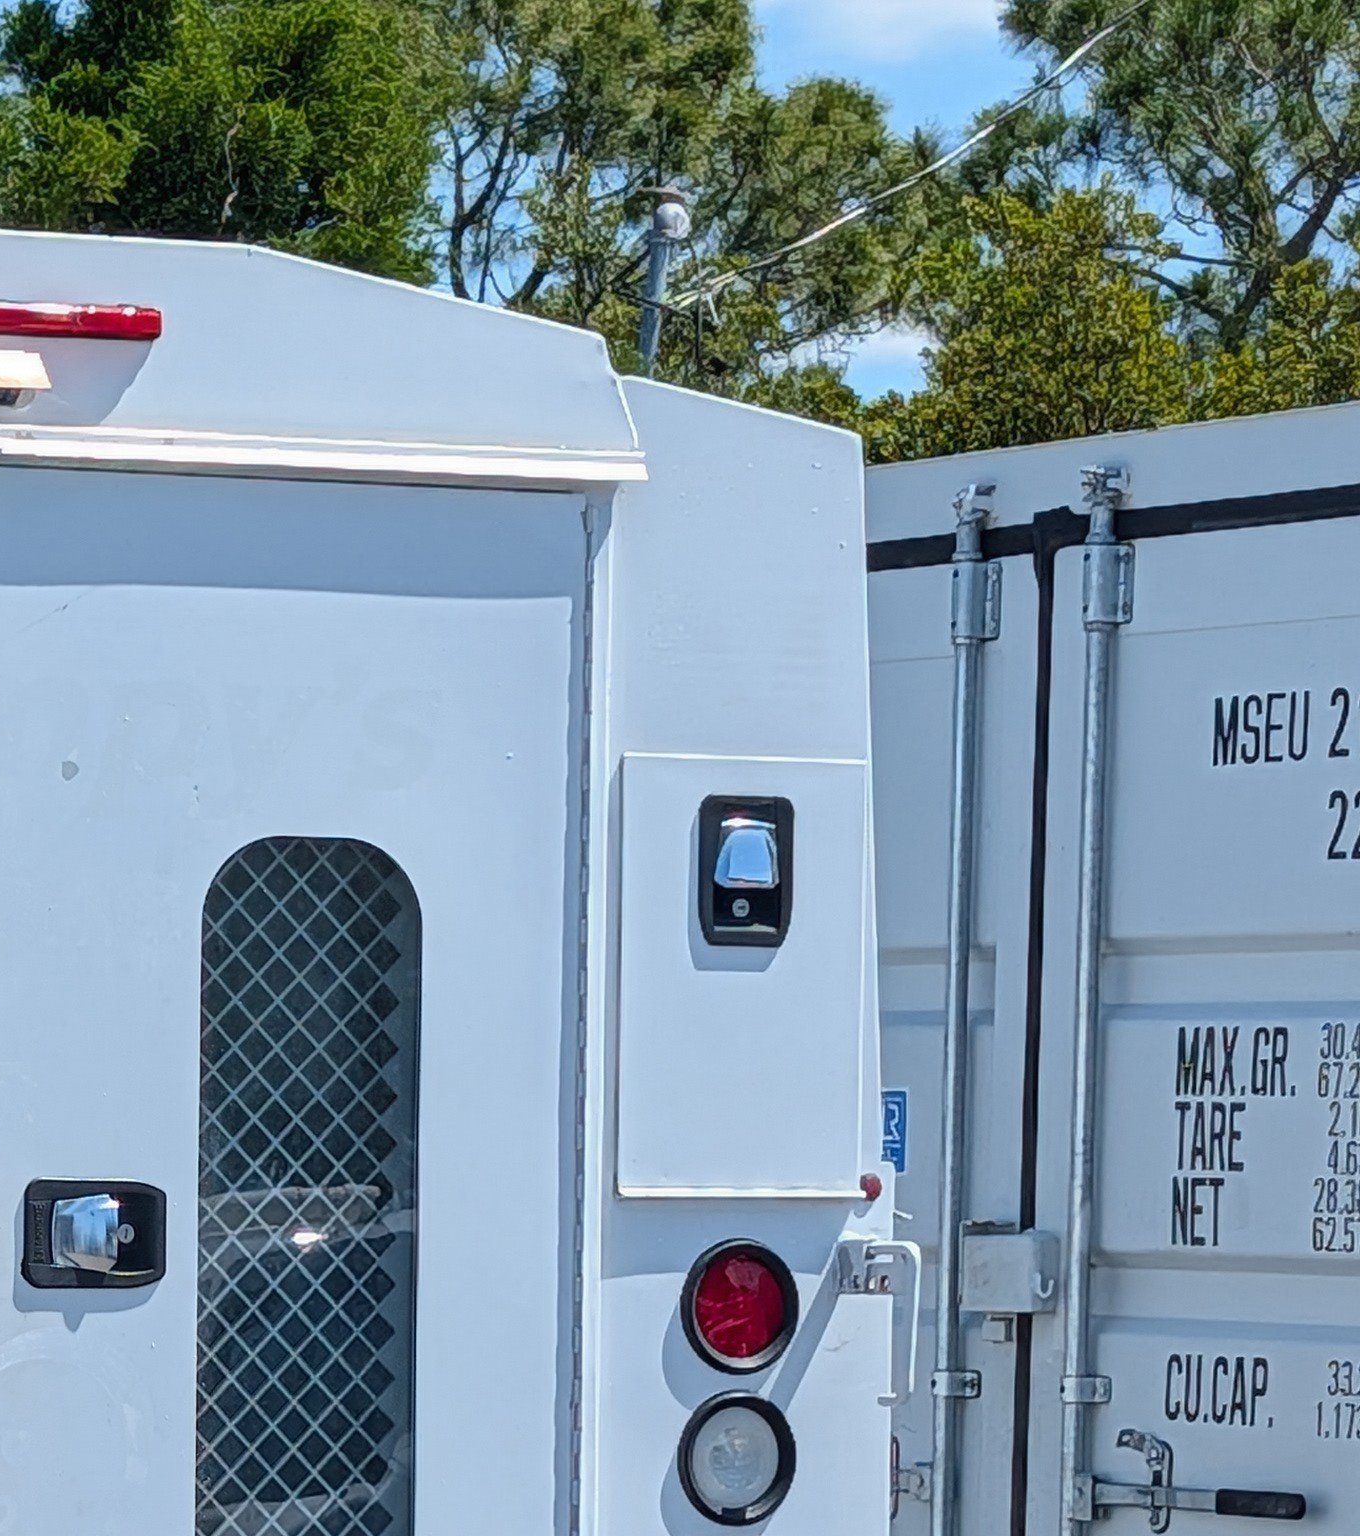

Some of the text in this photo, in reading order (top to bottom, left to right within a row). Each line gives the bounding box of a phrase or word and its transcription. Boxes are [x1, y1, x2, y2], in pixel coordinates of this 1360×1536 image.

[1212, 690, 1310, 767] MSEU
[1175, 1026, 1297, 1097] MAX.GR.
[1175, 1101, 1246, 1172] TARE
[1171, 1176, 1225, 1247] NET
[1165, 1353, 1274, 1429] CU.CAP.
[1316, 1401, 1360, 1439] 1,17
